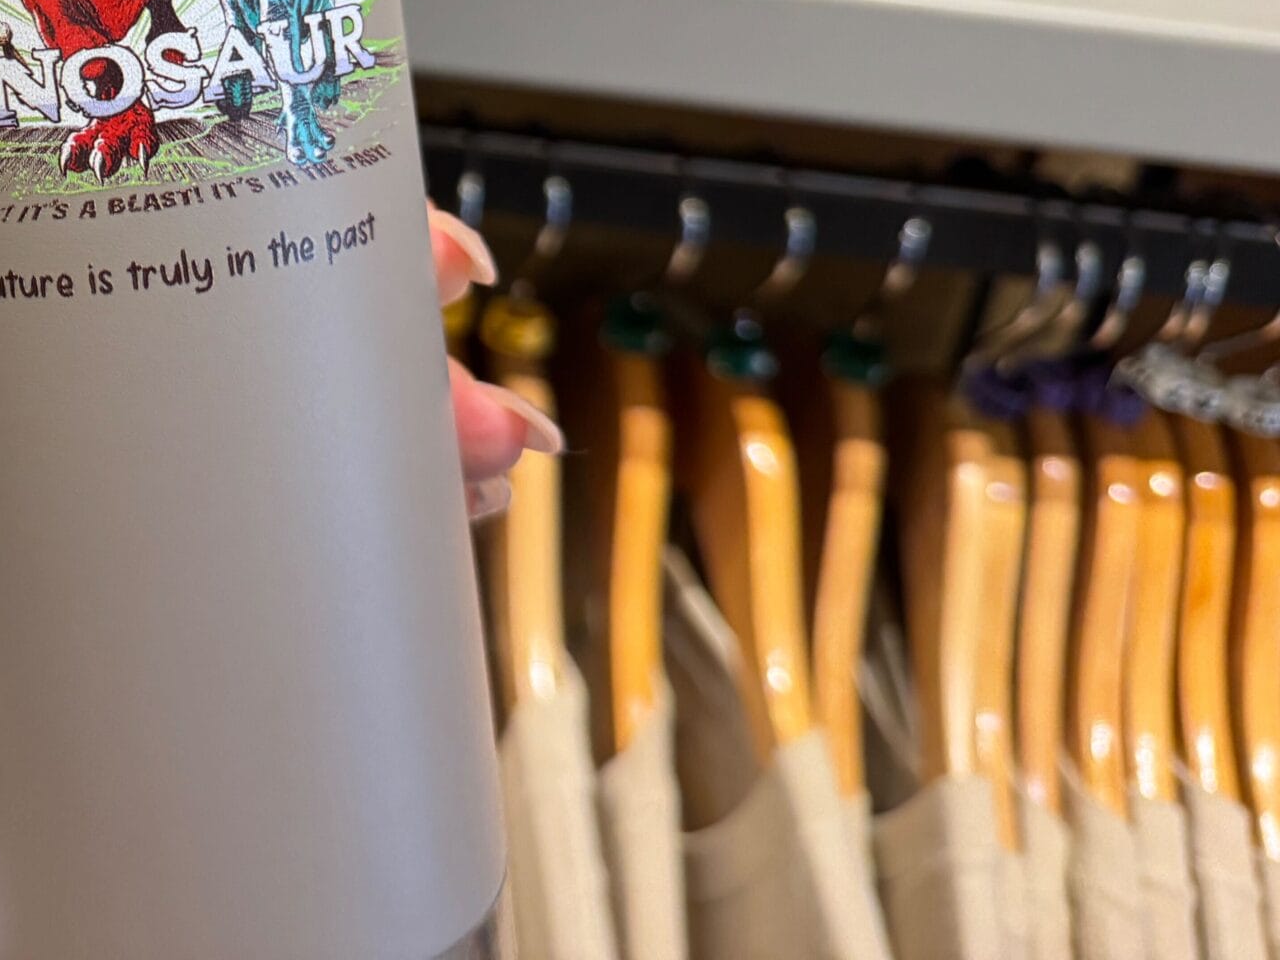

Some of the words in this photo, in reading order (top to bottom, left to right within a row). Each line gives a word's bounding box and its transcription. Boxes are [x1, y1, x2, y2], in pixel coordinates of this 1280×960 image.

[17, 198, 69, 223] IT'S
[78, 199, 97, 219] A
[108, 186, 204, 216] BLAST!
[210, 177, 264, 201] IT'S
[269, 170, 298, 189] IN
[301, 157, 345, 180] THE
[343, 144, 393, 170] PAST!
[88, 264, 114, 295] is
[126, 248, 214, 294] truly
[226, 246, 257, 277] in
[267, 230, 316, 267] the
[325, 212, 376, 265] past
